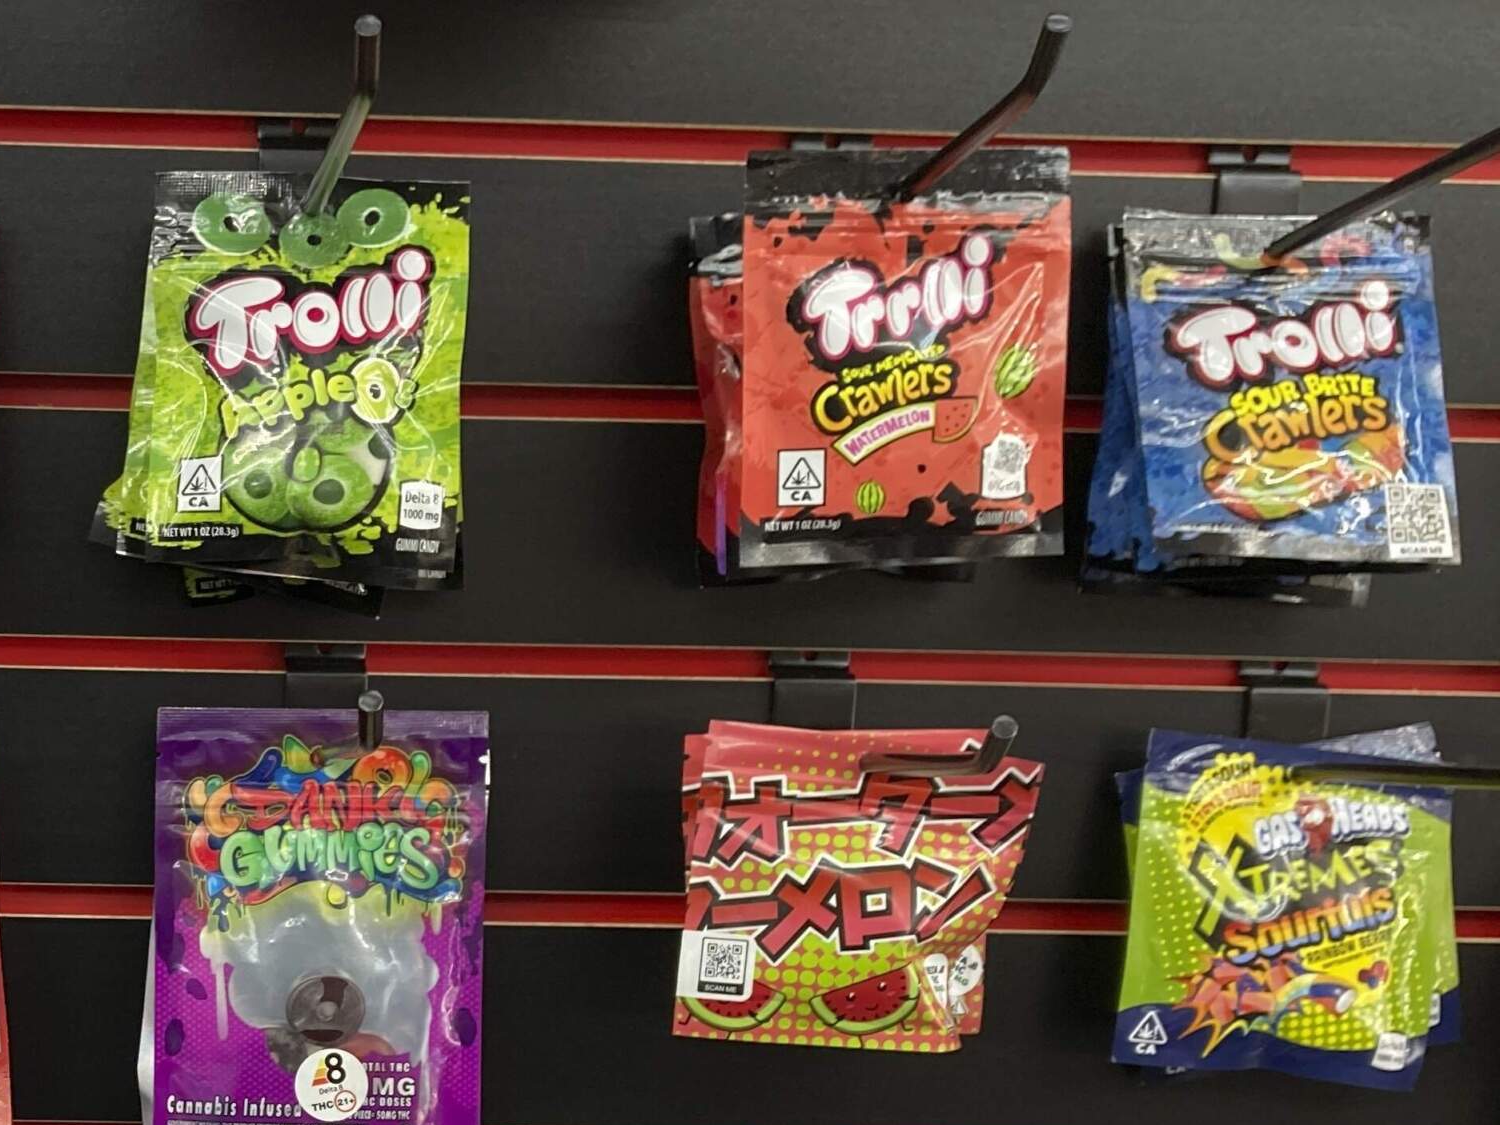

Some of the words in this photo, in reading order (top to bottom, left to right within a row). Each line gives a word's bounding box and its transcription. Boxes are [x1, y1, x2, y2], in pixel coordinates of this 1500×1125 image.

[196, 248, 427, 370] Trolli
[1179, 280, 1396, 381] Trolli
[813, 362, 954, 433] Crawlers
[1230, 381, 1299, 416] SOUR
[844, 409, 930, 457] WATERMELON
[1204, 396, 1387, 463] Crawlers
[189, 497, 209, 507] CA
[791, 491, 812, 501] CA
[404, 509, 423, 519] 1000
[424, 512, 439, 523] mg
[163, 527, 180, 537] NET
[181, 527, 193, 537] WT
[200, 527, 211, 537] OZ
[211, 526, 239, 538] (28.3g)
[1329, 798, 1409, 838] HEADS
[705, 985, 724, 993] SCAN
[1135, 1044, 1156, 1055] CA
[325, 1053, 347, 1085] 8
[372, 1077, 416, 1096] MG
[167, 1095, 237, 1117] Cannabis
[312, 1102, 334, 1113] THC
[380, 1098, 412, 1107] DOSES
